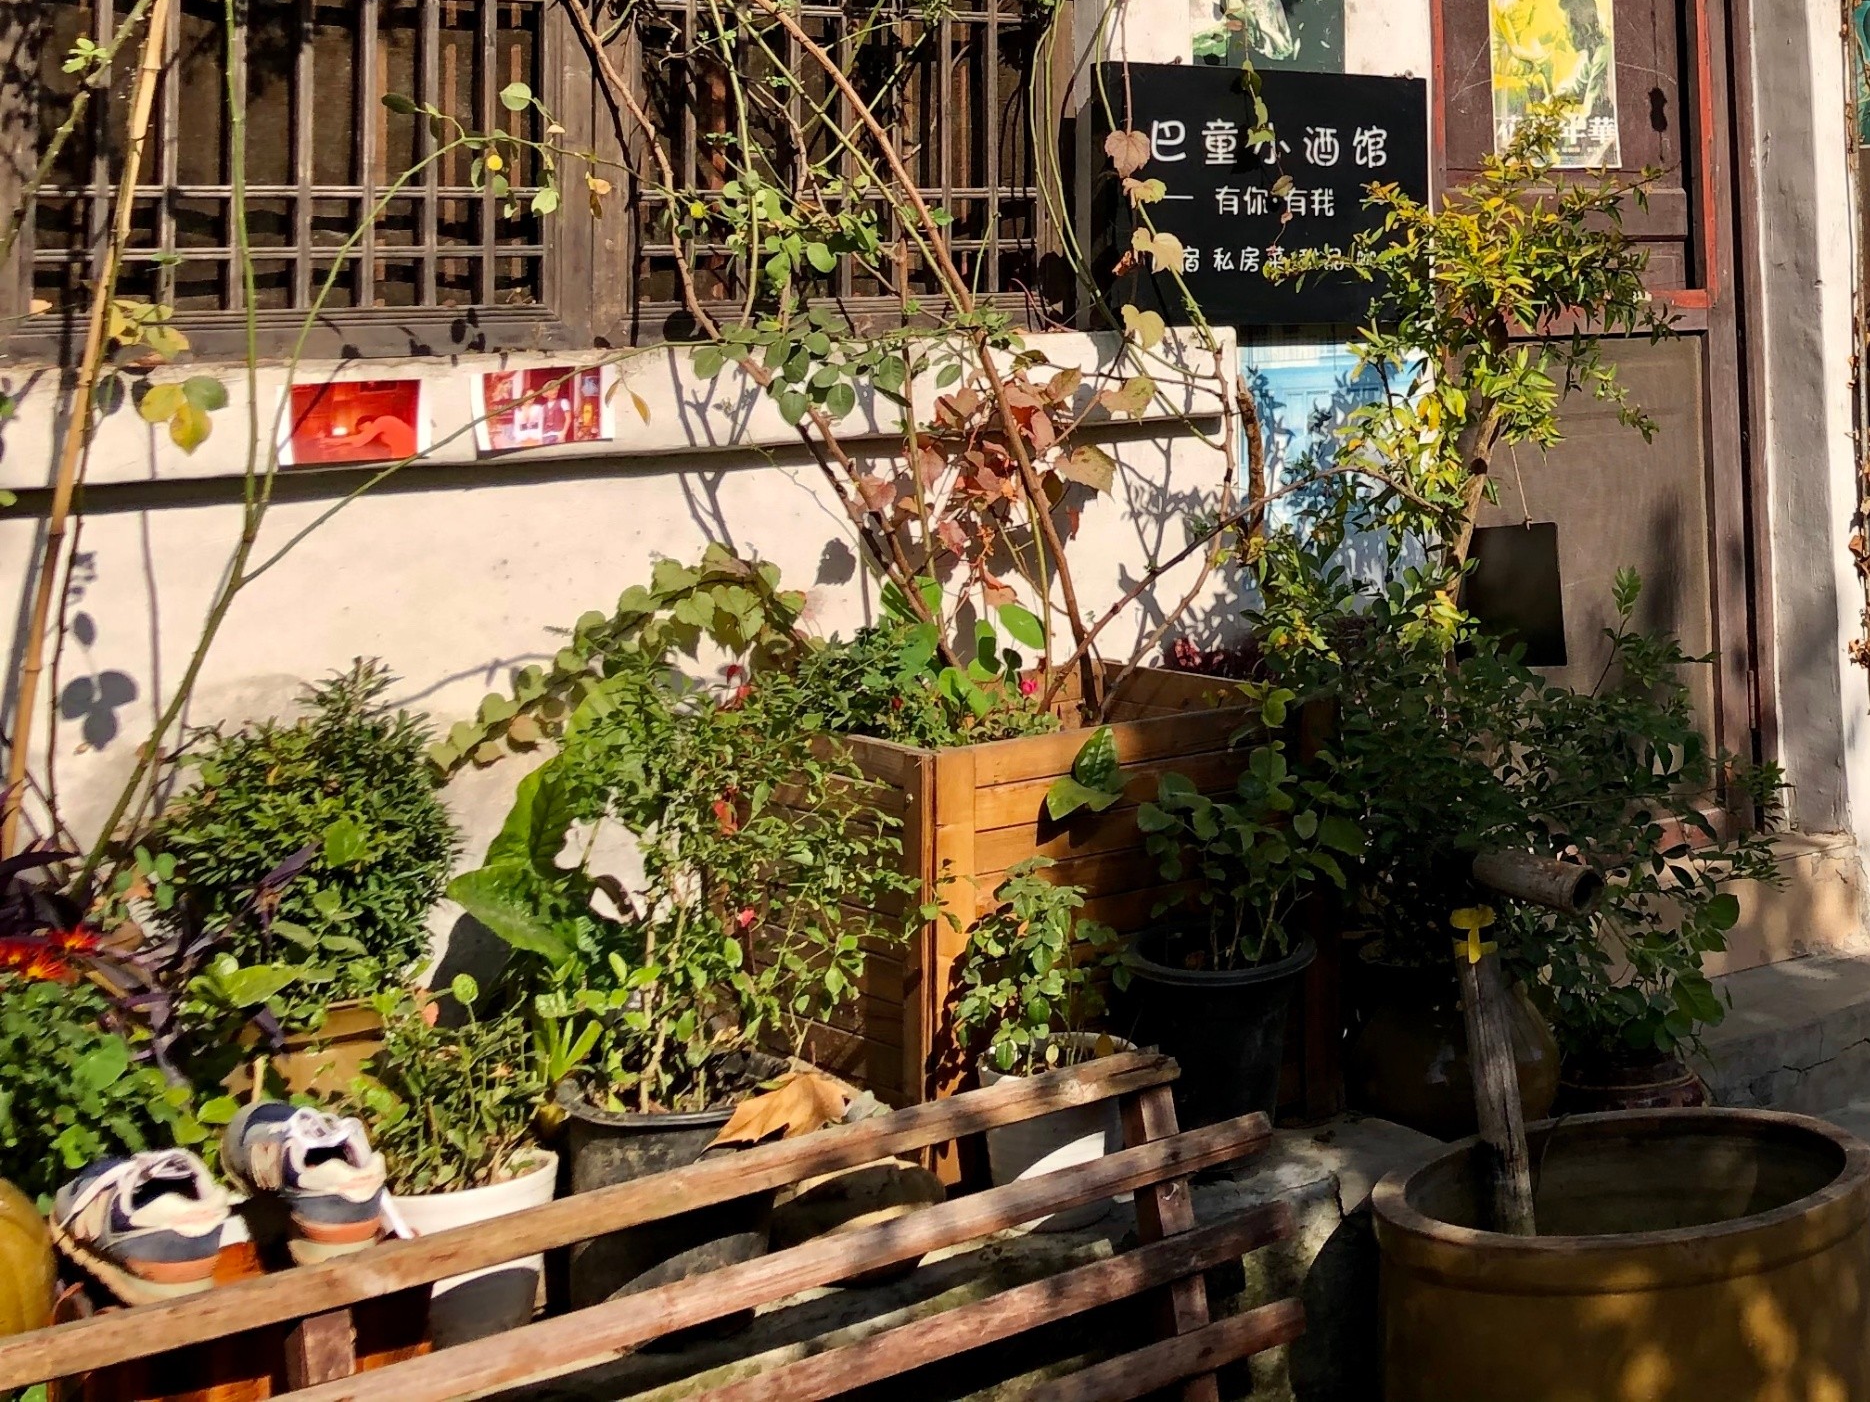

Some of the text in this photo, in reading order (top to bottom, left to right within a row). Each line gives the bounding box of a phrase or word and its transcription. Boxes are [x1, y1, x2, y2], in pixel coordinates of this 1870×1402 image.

[1150, 117, 1388, 169] 巴童小酒馆
